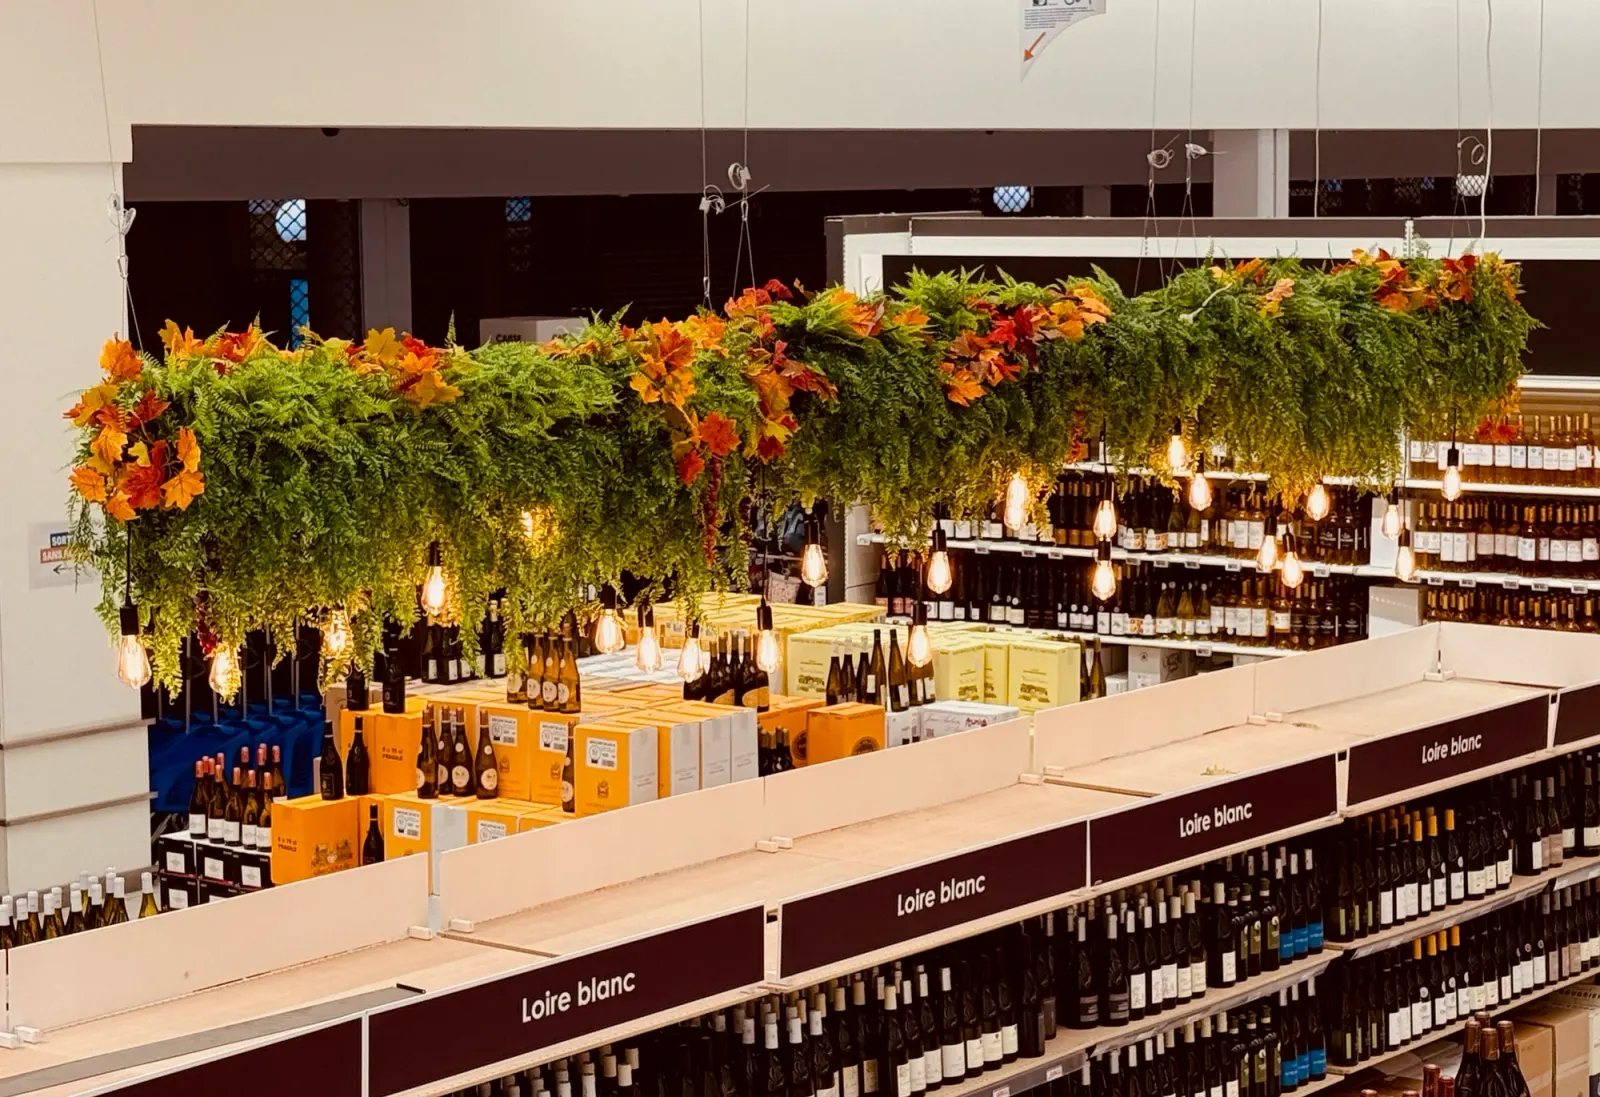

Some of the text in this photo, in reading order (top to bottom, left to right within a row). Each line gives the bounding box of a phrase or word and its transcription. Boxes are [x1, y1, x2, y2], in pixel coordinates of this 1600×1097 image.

[1422, 734, 1482, 764] Loire blanc
[1180, 802, 1252, 838] Loire blanc
[897, 875, 986, 917] Loire blanc
[522, 972, 636, 1024] Loire blanc
